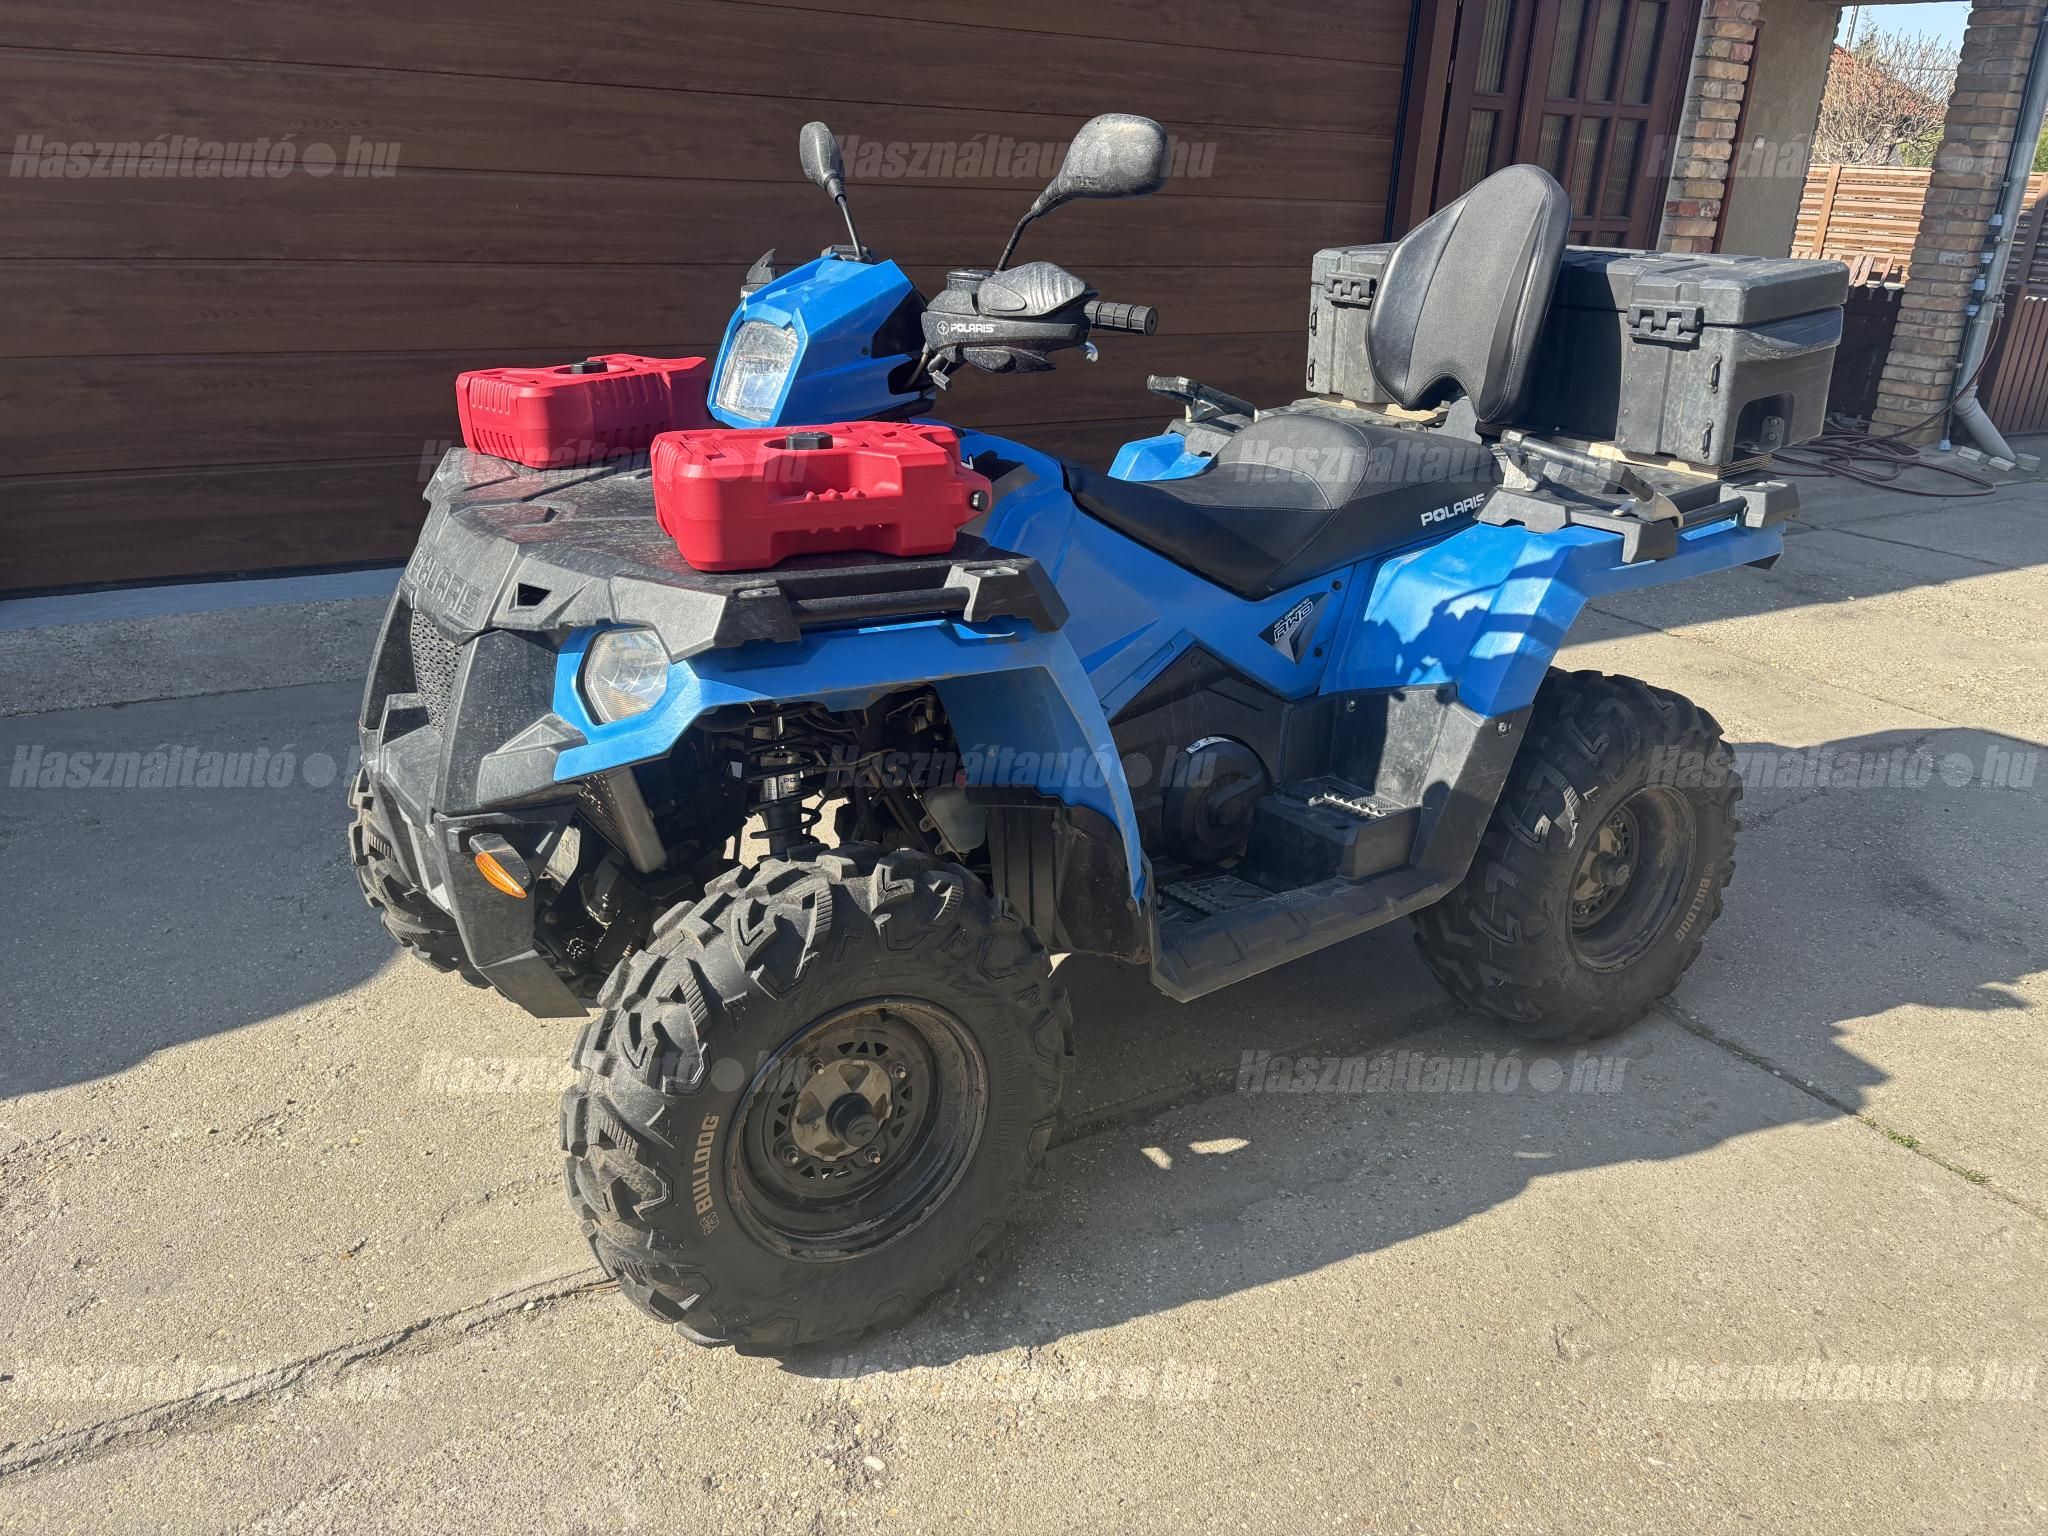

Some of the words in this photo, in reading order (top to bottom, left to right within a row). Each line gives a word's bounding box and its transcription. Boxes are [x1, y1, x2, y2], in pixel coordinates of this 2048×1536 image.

[950, 322, 996, 334] POLARIS
[1420, 493, 1485, 527] POLARIS
[692, 1113, 720, 1216] BULLDOG
